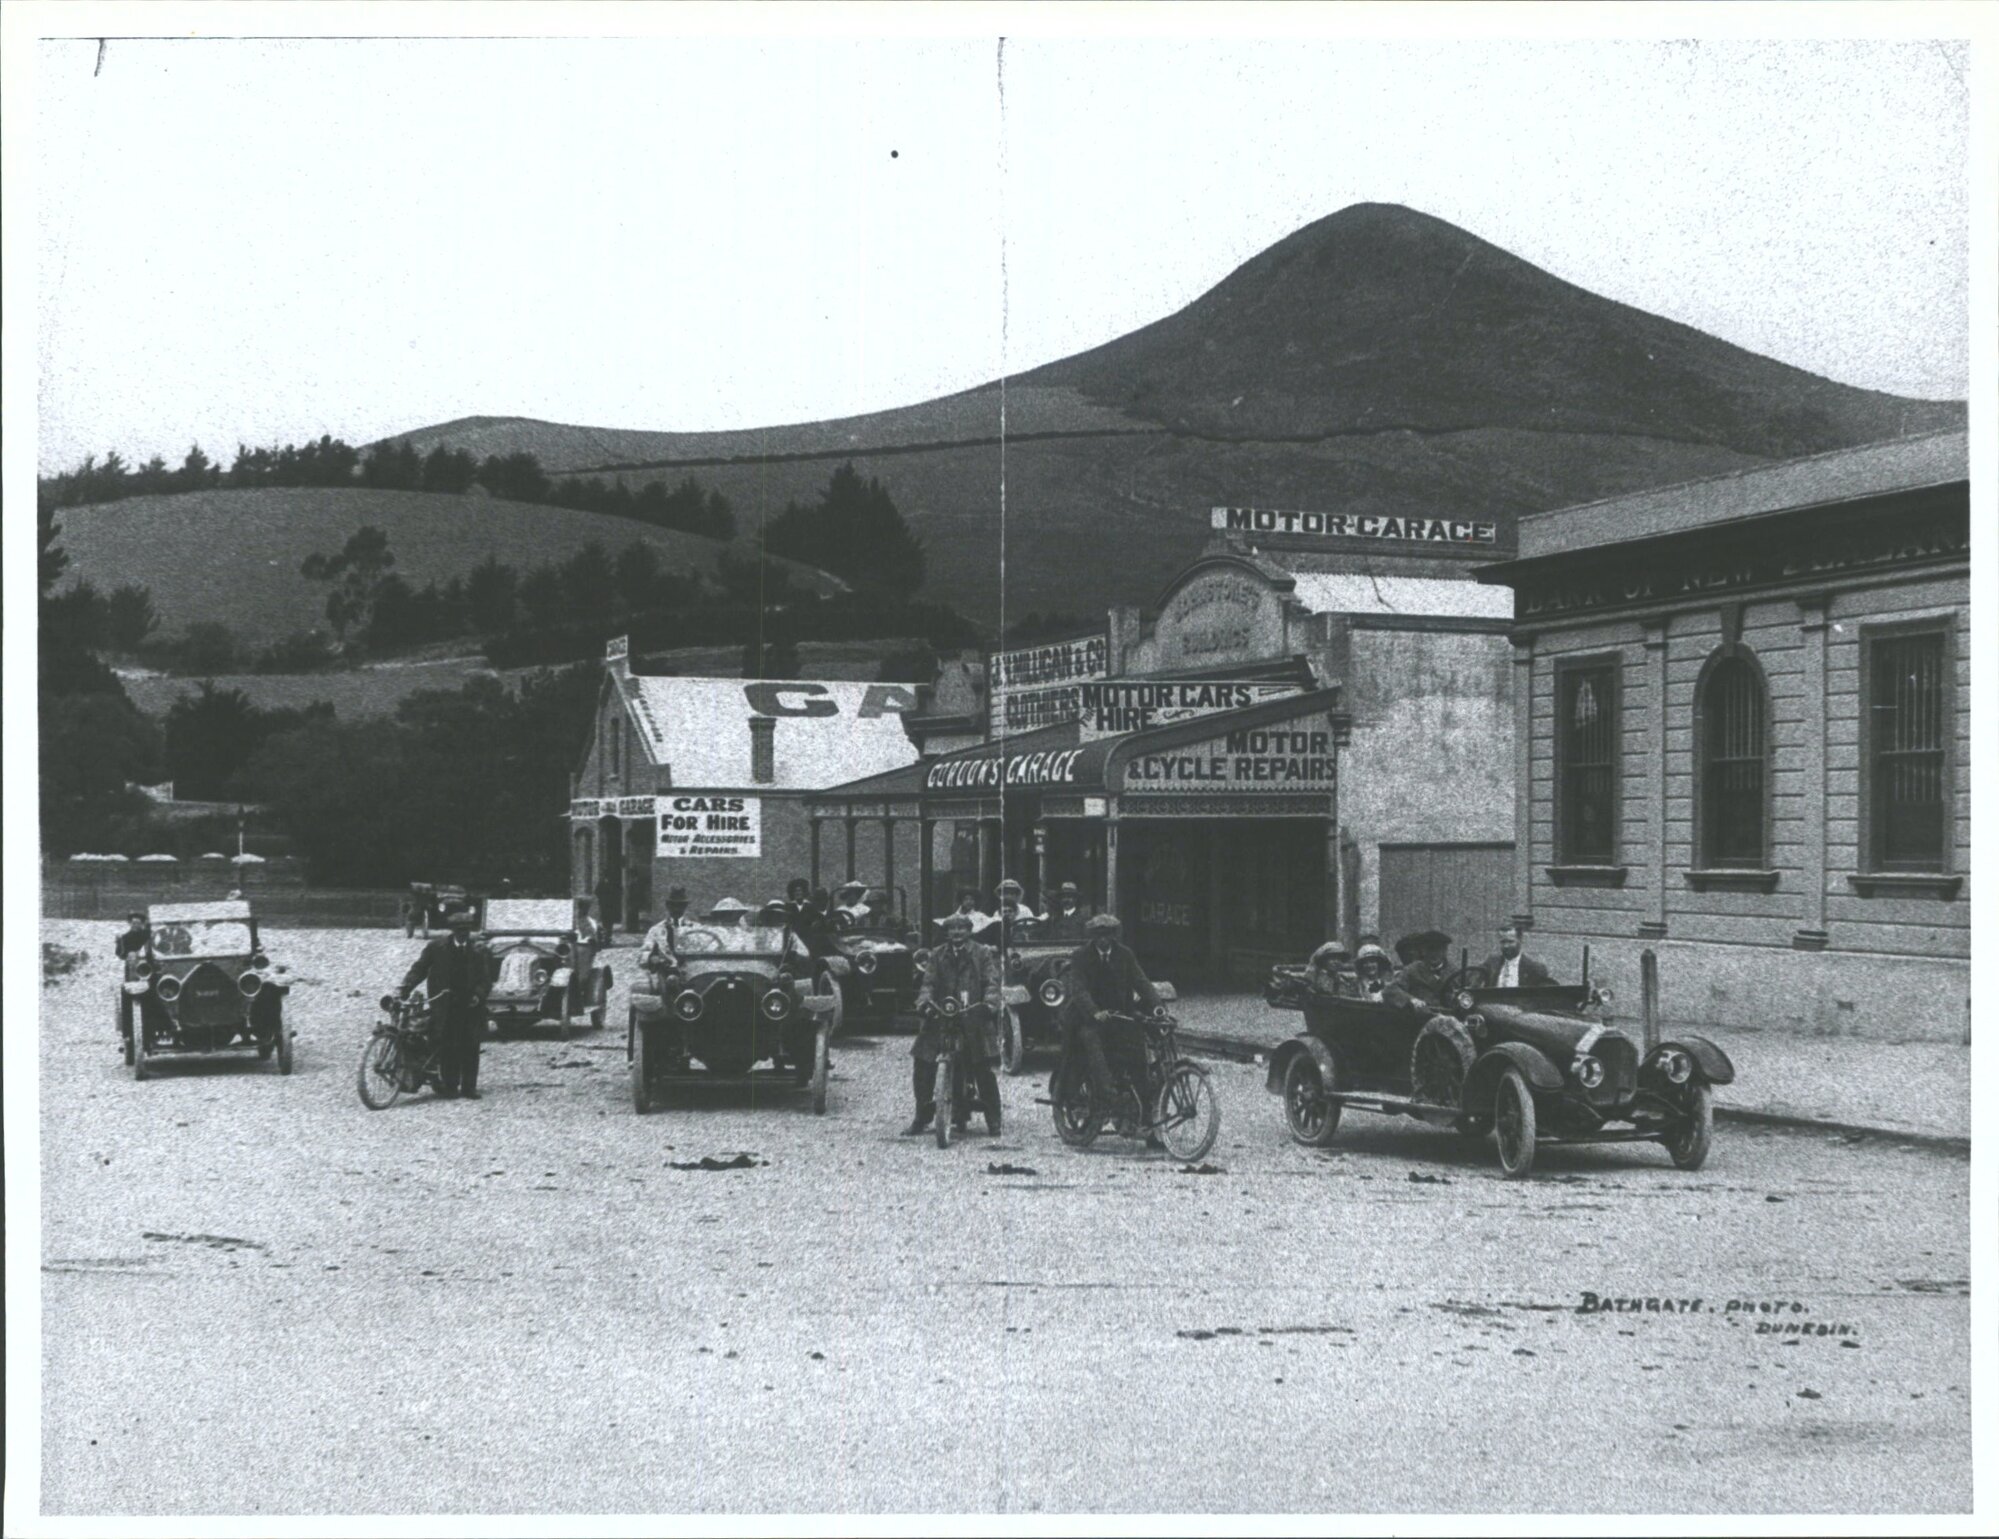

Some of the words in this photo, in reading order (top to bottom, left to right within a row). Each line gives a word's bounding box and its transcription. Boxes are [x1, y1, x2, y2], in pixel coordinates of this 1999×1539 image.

[1082, 684, 1173, 708] MOTOR
[1179, 684, 1251, 708] CARS
[1096, 707, 1157, 731] HIRE
[1227, 731, 1329, 755] MOTOR
[1006, 748, 1085, 784] GARAGE
[1235, 758, 1337, 781] REPAIRS
[673, 797, 744, 812] CARS
[661, 814, 698, 830] FOR
[706, 814, 750, 831] HIRE
[661, 834, 689, 843] MOTOR
[692, 833, 755, 844] ACCESSORIES
